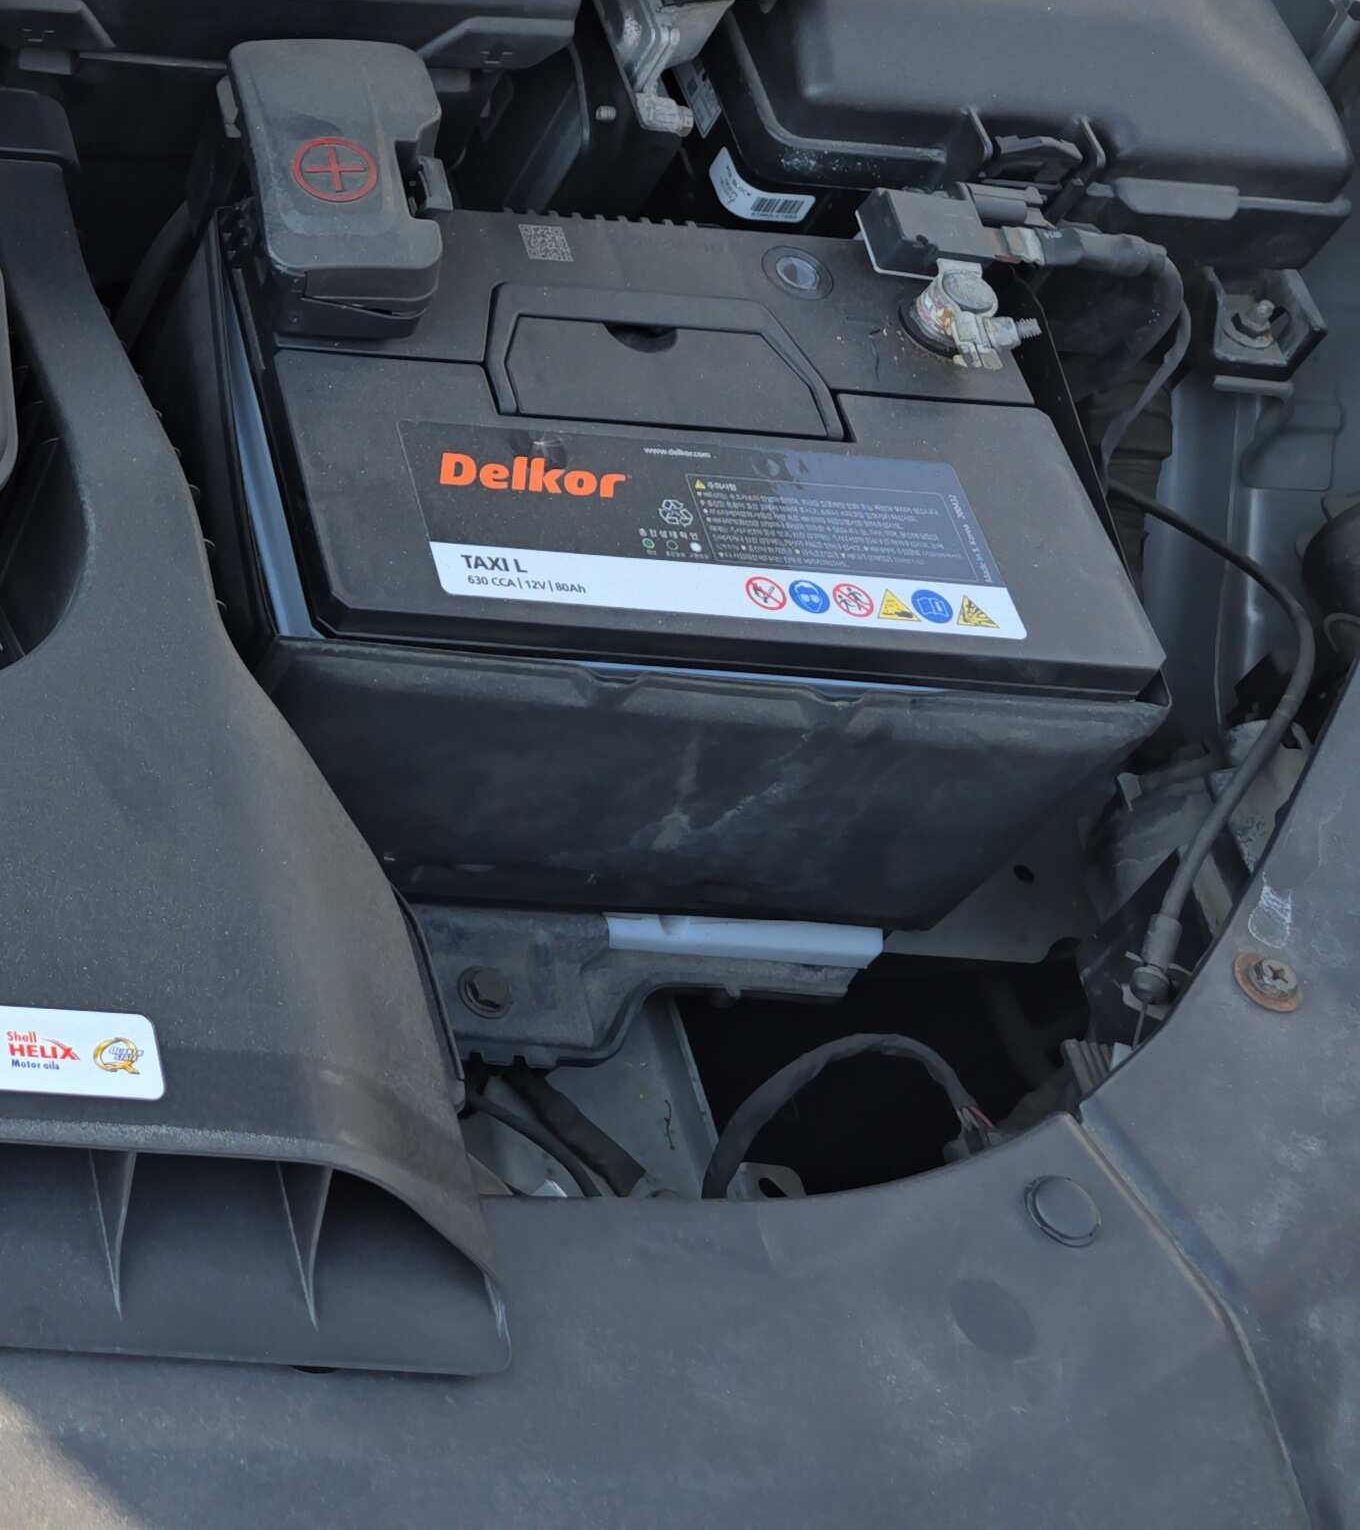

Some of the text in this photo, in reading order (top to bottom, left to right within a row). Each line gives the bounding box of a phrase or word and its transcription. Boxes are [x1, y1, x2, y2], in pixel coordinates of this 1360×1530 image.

[439, 451, 627, 499] Delkor
[460, 554, 529, 573] TAXI L
[467, 574, 587, 594] 630 CCA 12V 80Ah
[6, 1030, 38, 1043] Shell
[8, 1043, 79, 1061] HELIX
[11, 1058, 60, 1070] Motor oils
